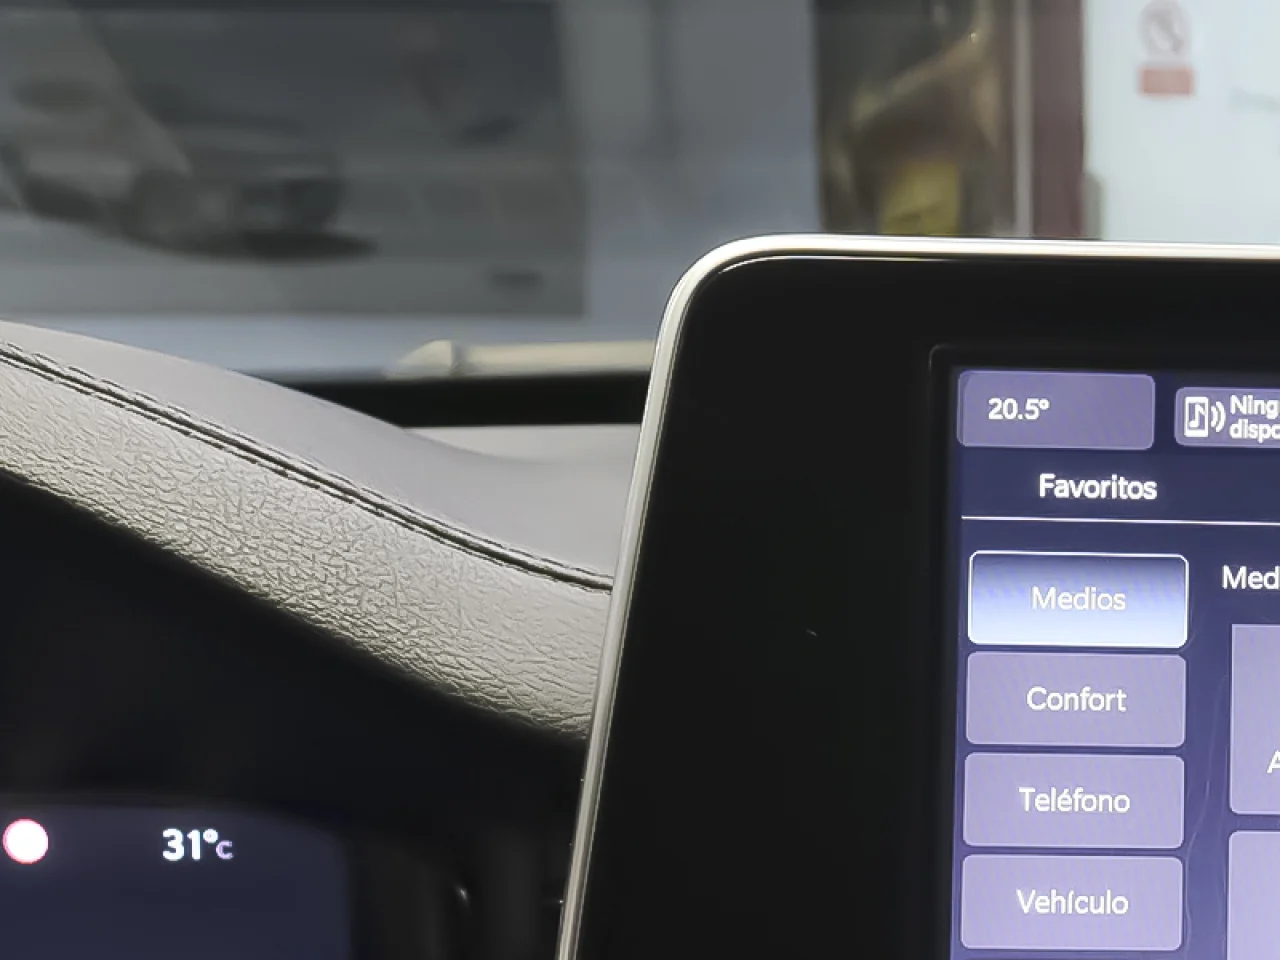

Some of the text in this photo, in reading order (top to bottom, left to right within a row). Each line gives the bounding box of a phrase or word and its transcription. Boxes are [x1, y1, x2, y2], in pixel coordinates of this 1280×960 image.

[1038, 473, 1158, 500] Favoritos
[1031, 586, 1127, 611] Medios
[1025, 686, 1127, 713] Confort
[1018, 786, 1131, 813] Teléfono
[1016, 889, 1129, 916] Vehículo
